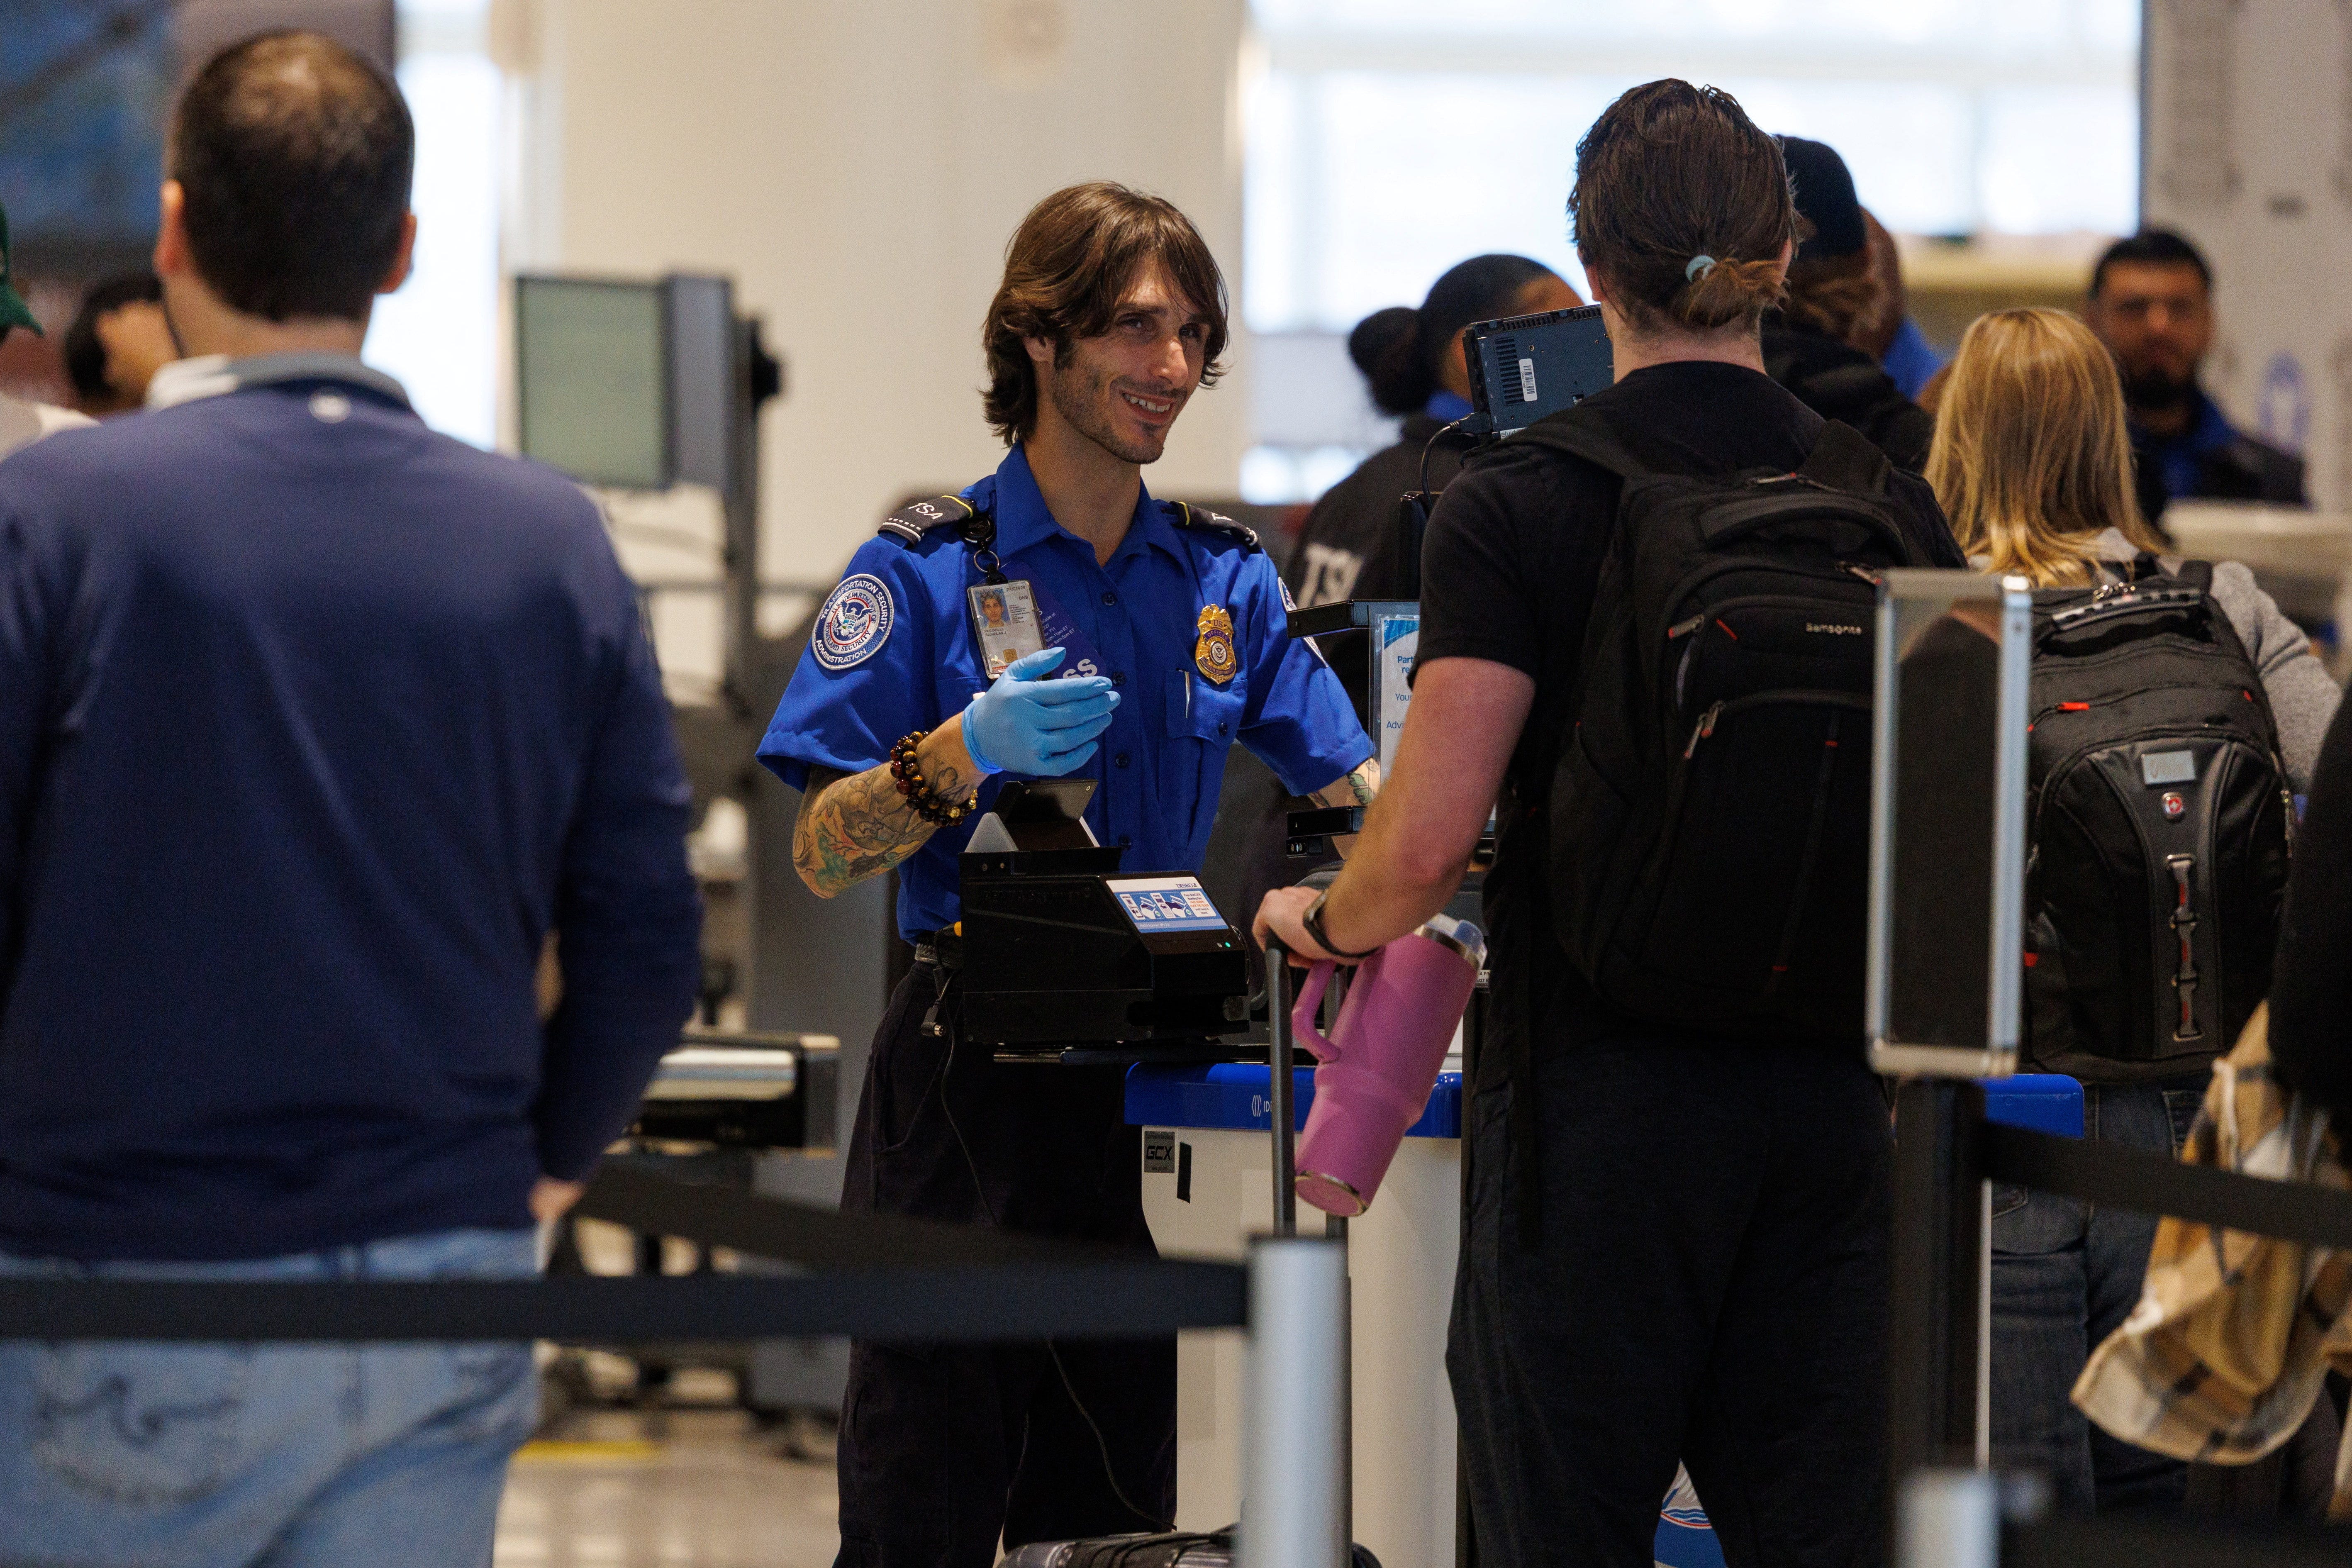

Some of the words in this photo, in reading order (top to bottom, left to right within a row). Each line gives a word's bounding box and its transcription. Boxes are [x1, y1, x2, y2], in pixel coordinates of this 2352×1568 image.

[909, 503, 943, 519] TSA
[821, 580, 878, 619] TRANSPORTATION
[876, 592, 887, 632] SECURITY
[871, 615, 877, 624] OF
[1214, 619, 1223, 628] US
[841, 631, 870, 652] SECURITY
[1207, 630, 1228, 640] OFFICER
[816, 640, 867, 663] ADMINISTRATION
[1146, 1146, 1172, 1160] GCX
